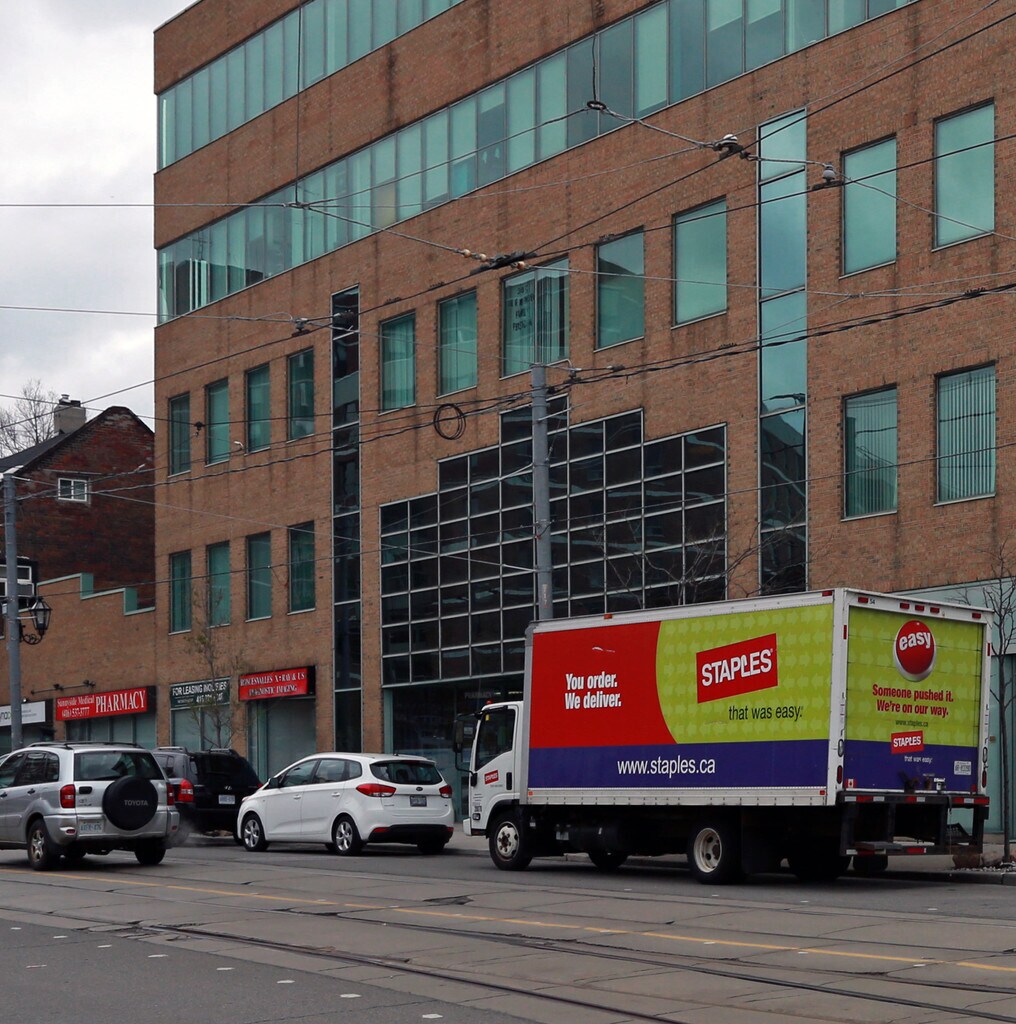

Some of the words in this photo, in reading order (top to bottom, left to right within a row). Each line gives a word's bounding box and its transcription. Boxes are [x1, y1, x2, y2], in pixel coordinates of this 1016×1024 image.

[899, 631, 931, 651] easy
[702, 648, 773, 687] STAPLES
[172, 686, 182, 696] FOR
[183, 684, 202, 694] LEASING
[240, 675, 273, 687] RONCESVALLES
[565, 673, 585, 691] You
[587, 671, 618, 689] order.
[78, 695, 95, 705] Medical
[95, 690, 146, 714] PHARMACY
[564, 692, 581, 710] We
[583, 690, 622, 709] deliver.
[872, 684, 911, 699] Someone
[913, 689, 944, 702] pushed
[945, 690, 954, 702] it.
[728, 705, 748, 720] that
[751, 706, 773, 719] was
[876, 699, 900, 713] We're
[902, 704, 913, 713] on
[914, 704, 928, 714] our
[930, 706, 949, 718] way.
[893, 736, 922, 748] STAPLES
[617, 755, 716, 778] www.staples.ca
